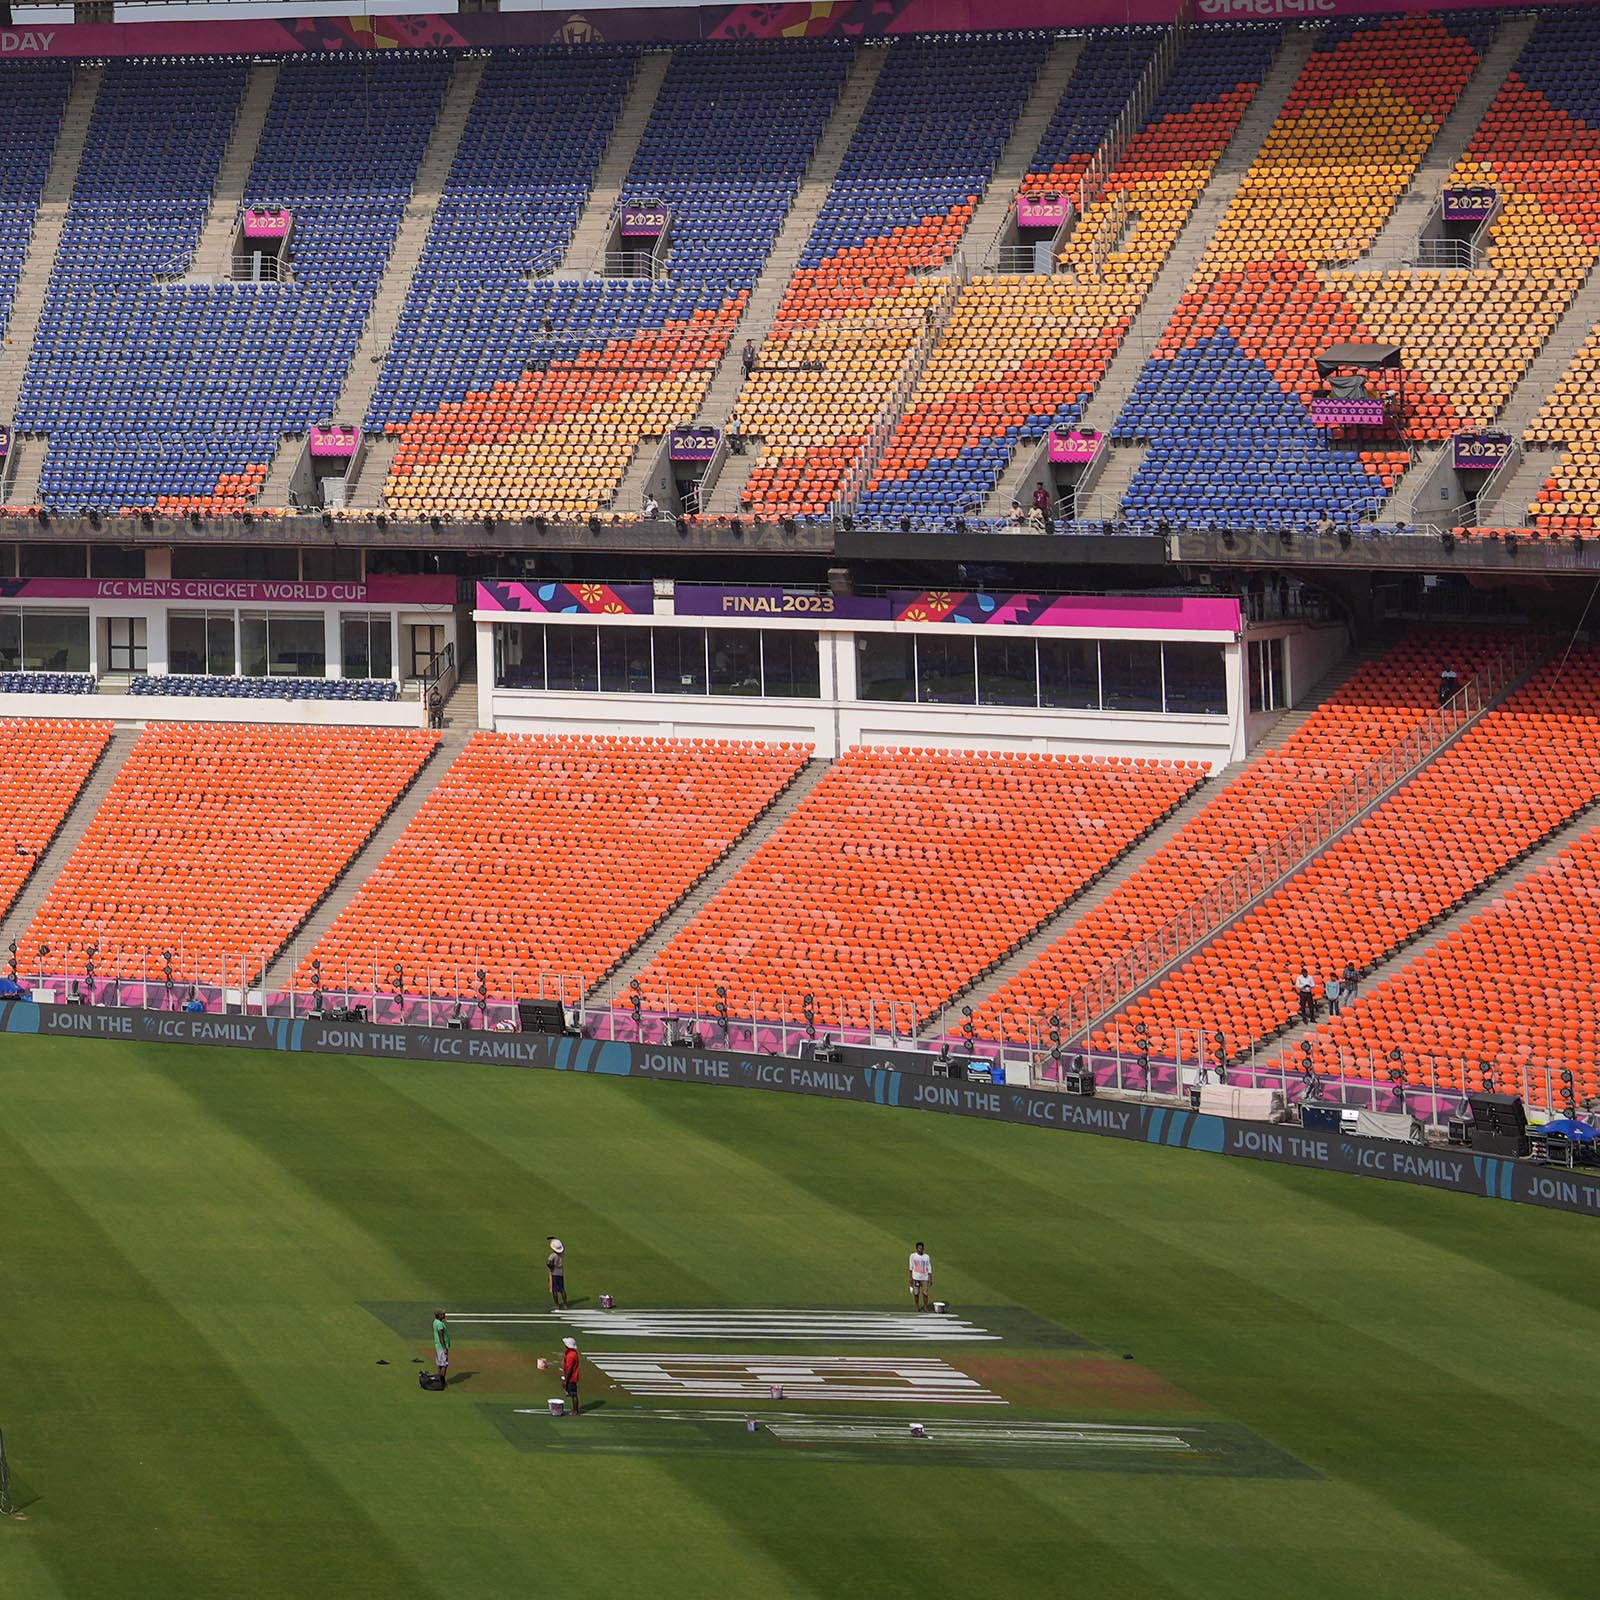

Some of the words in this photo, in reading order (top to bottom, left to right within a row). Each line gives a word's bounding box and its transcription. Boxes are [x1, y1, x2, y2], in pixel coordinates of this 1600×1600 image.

[1, 32, 55, 52] DAY
[97, 582, 125, 597] ICC
[128, 582, 181, 597] MEN'S
[185, 582, 258, 599] CRICKET
[263, 584, 328, 600] WORLD
[332, 585, 367, 600] CUP
[722, 595, 782, 613] FINAL
[782, 595, 834, 613] 2023
[48, 1012, 92, 1030] JOIN
[97, 1015, 132, 1033] THE
[158, 1019, 185, 1036] ICC
[191, 1022, 256, 1041] FAMILY
[317, 1030, 365, 1049] JOIN
[369, 1034, 406, 1052] THE
[433, 1038, 461, 1055] ICC
[468, 1041, 537, 1060] FAMILY
[640, 1054, 687, 1075] JOIN
[692, 1059, 729, 1078] THE
[756, 1065, 784, 1084] ICC
[790, 1070, 854, 1091] FAMILY
[914, 1085, 960, 1106] JOIN
[964, 1091, 1000, 1112] THE
[1027, 1100, 1056, 1120] ICC
[1062, 1105, 1130, 1130] FAMILY
[1233, 1130, 1283, 1154] JOIN
[1288, 1137, 1328, 1161] THE
[1357, 1149, 1385, 1170] ICC
[1393, 1154, 1463, 1182] FAMILY
[1528, 1177, 1577, 1204] JOIN
